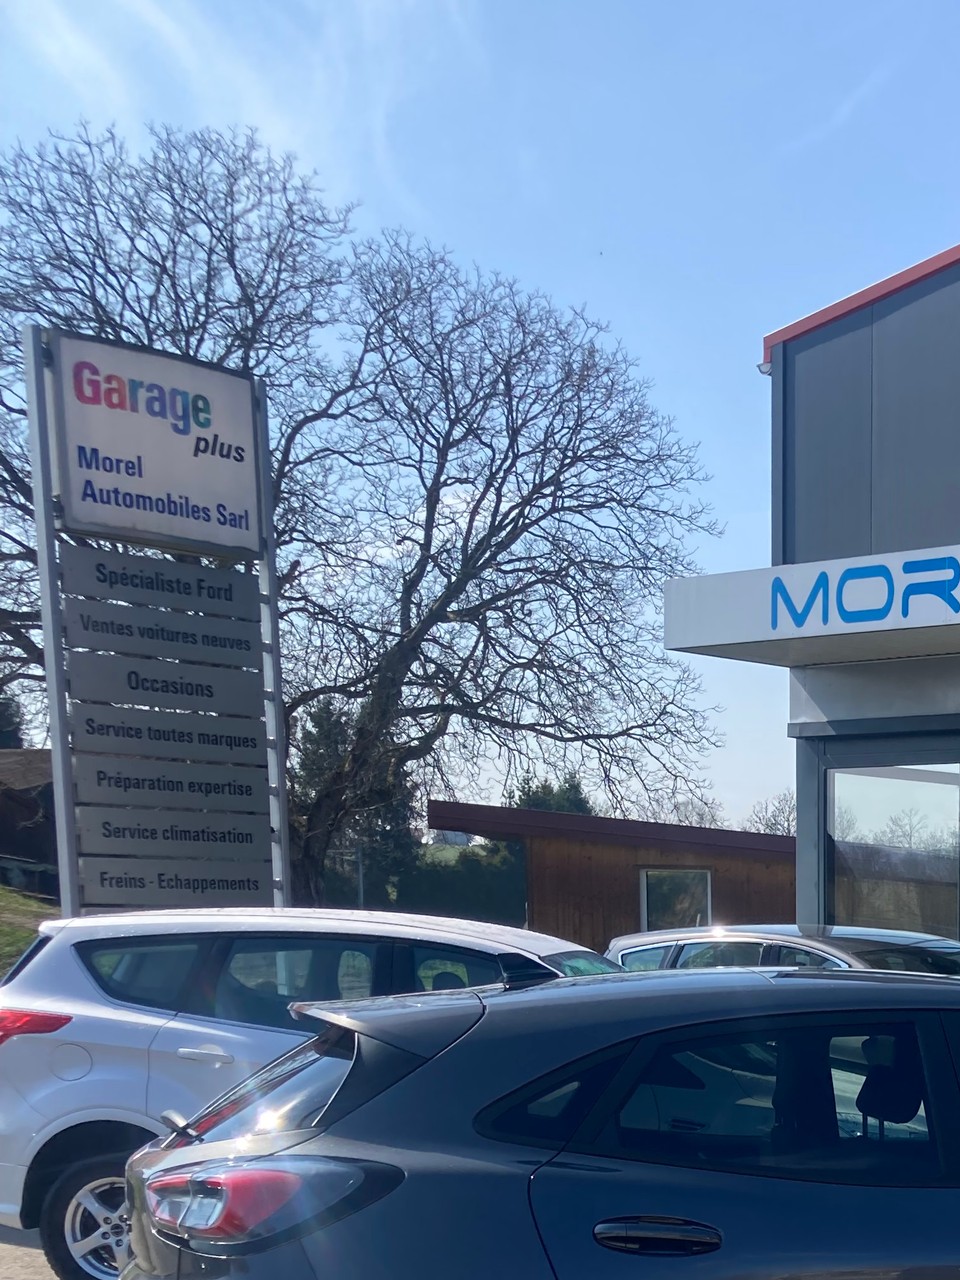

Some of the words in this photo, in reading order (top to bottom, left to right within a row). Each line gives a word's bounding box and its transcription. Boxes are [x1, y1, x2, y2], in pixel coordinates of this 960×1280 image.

[73, 361, 212, 435] Garage
[77, 445, 144, 478] Morel
[193, 434, 246, 463] plus
[81, 479, 211, 522] Automobiles
[216, 503, 250, 531] Sarl
[95, 563, 192, 596] Spécialiste
[196, 579, 233, 602] Ford
[80, 614, 134, 637] Ventes
[138, 624, 198, 645] voitures
[202, 633, 251, 651] neuves
[127, 671, 214, 698] Occasions
[85, 718, 143, 740] Service
[147, 726, 193, 744] toutes
[197, 733, 257, 750] marques
[96, 770, 184, 793] Préparation
[188, 780, 252, 797] expertise
[102, 822, 158, 840] Service
[162, 825, 253, 844] climatisation
[99, 871, 146, 889] Freins
[157, 873, 259, 893] Echappements
